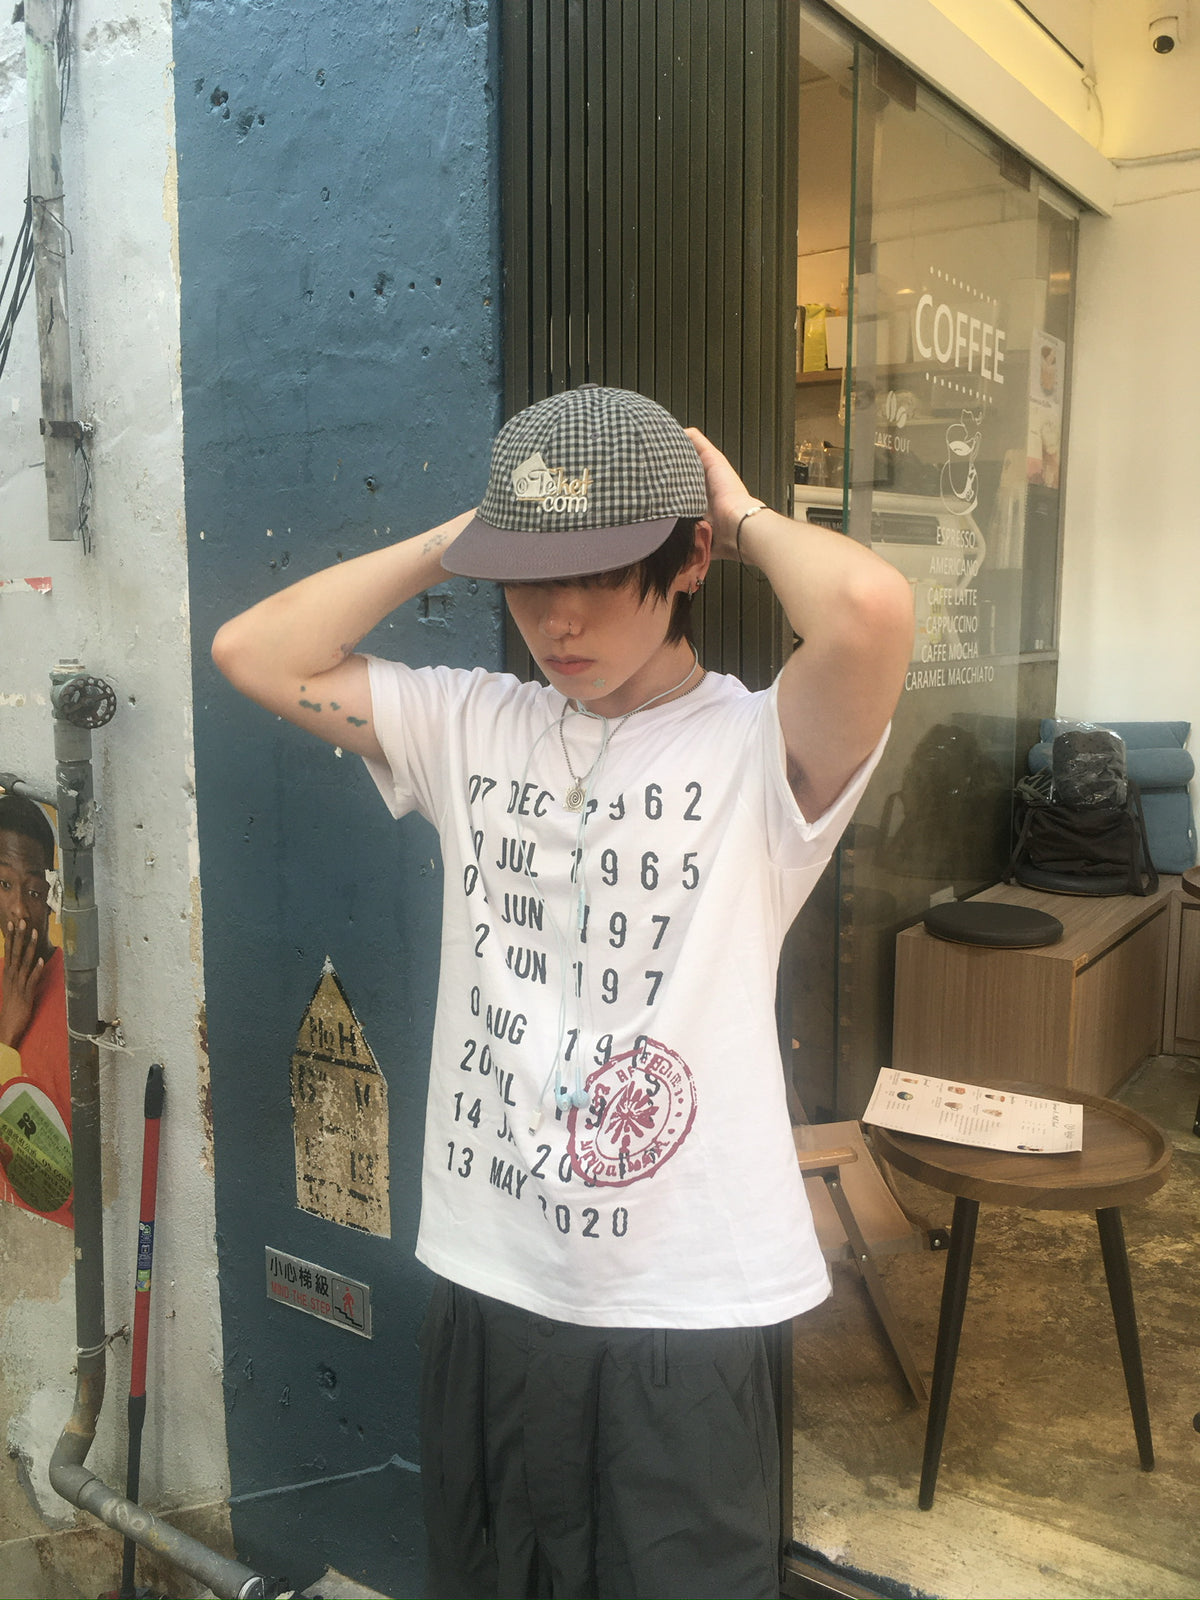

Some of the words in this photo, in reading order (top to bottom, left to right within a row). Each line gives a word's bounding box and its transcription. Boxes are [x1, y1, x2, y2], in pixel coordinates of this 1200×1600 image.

[915, 294, 1006, 384] COFFEE
[536, 496, 588, 513] .com
[936, 526, 976, 549] ESPRESSO
[929, 557, 979, 577] AMERICANO
[927, 587, 952, 606] CAFFE
[954, 589, 978, 606] LATTE
[926, 615, 978, 634] CAPPUCCINO
[921, 643, 946, 663] CAFFE
[949, 642, 979, 662] MOCHA
[905, 668, 945, 692] CARAMEL
[948, 665, 994, 685] MACCHIATO
[507, 780, 556, 818] DEC
[495, 837, 539, 878] JUL
[501, 892, 545, 931] JUN
[504, 946, 547, 985] JUN
[486, 1004, 528, 1046] AUG
[459, 1038, 492, 1077] 20
[453, 1091, 482, 1129] 14
[447, 1141, 474, 1179] 13
[489, 1156, 529, 1201] MAY
[269, 1256, 330, 1298] 小心梯級
[271, 1280, 290, 1300] MIND
[292, 1289, 308, 1307] THE
[310, 1296, 331, 1315] STEP
